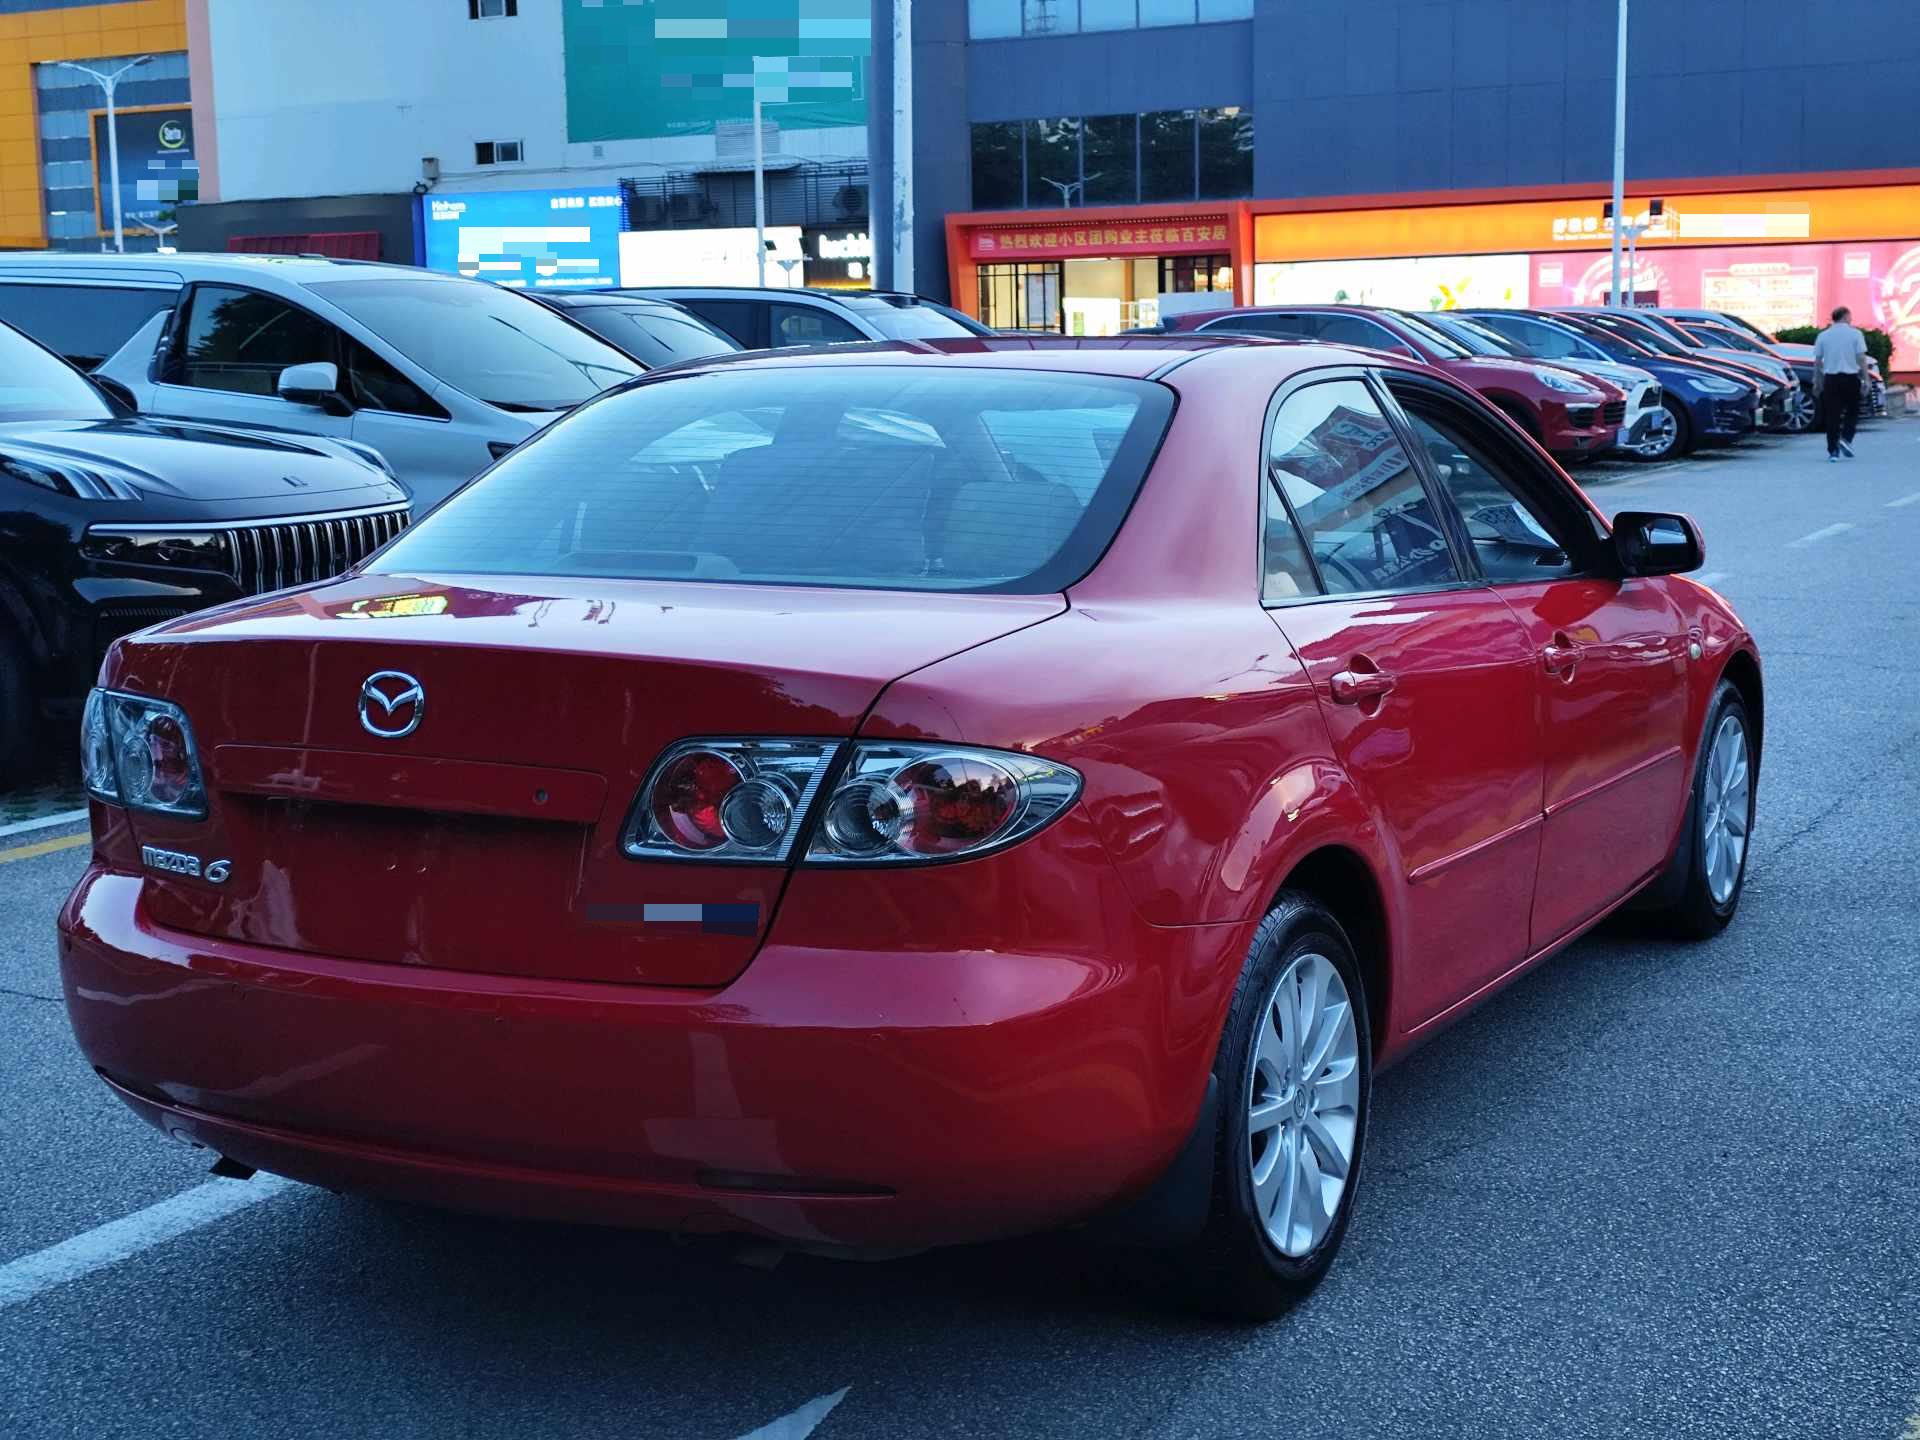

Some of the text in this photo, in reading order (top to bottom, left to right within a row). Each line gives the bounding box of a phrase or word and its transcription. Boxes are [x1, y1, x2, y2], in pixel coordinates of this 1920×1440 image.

[1000, 225, 1227, 249] 热烈欢迎小区团购业主莅临百安居
[142, 845, 232, 883] mazda 6
